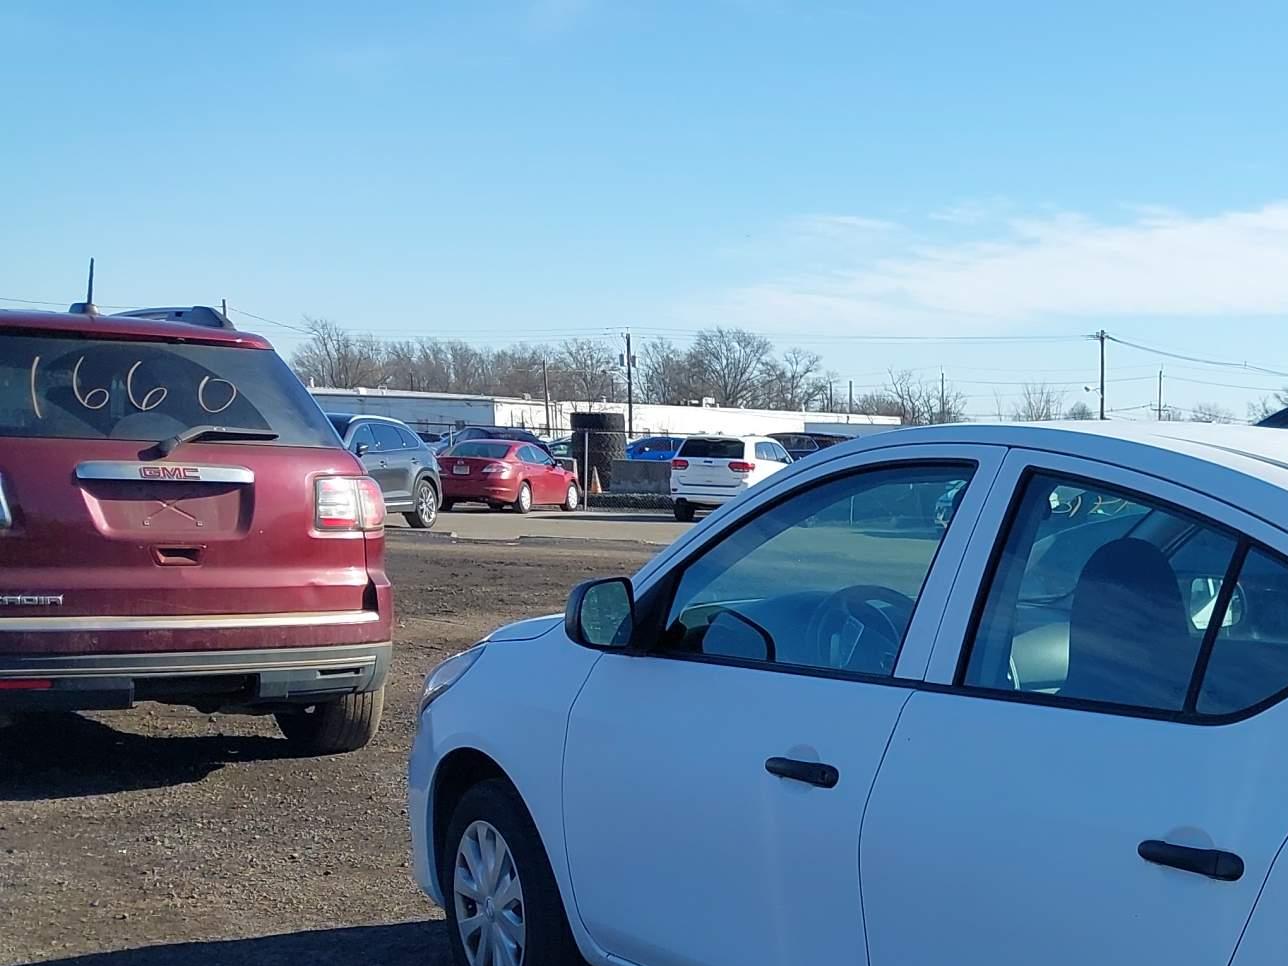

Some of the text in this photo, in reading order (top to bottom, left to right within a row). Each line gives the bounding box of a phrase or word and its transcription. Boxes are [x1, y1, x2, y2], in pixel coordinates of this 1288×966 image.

[31, 355, 237, 419] 1660
[139, 466, 201, 480] GMC
[0, 594, 63, 606] ADIA
